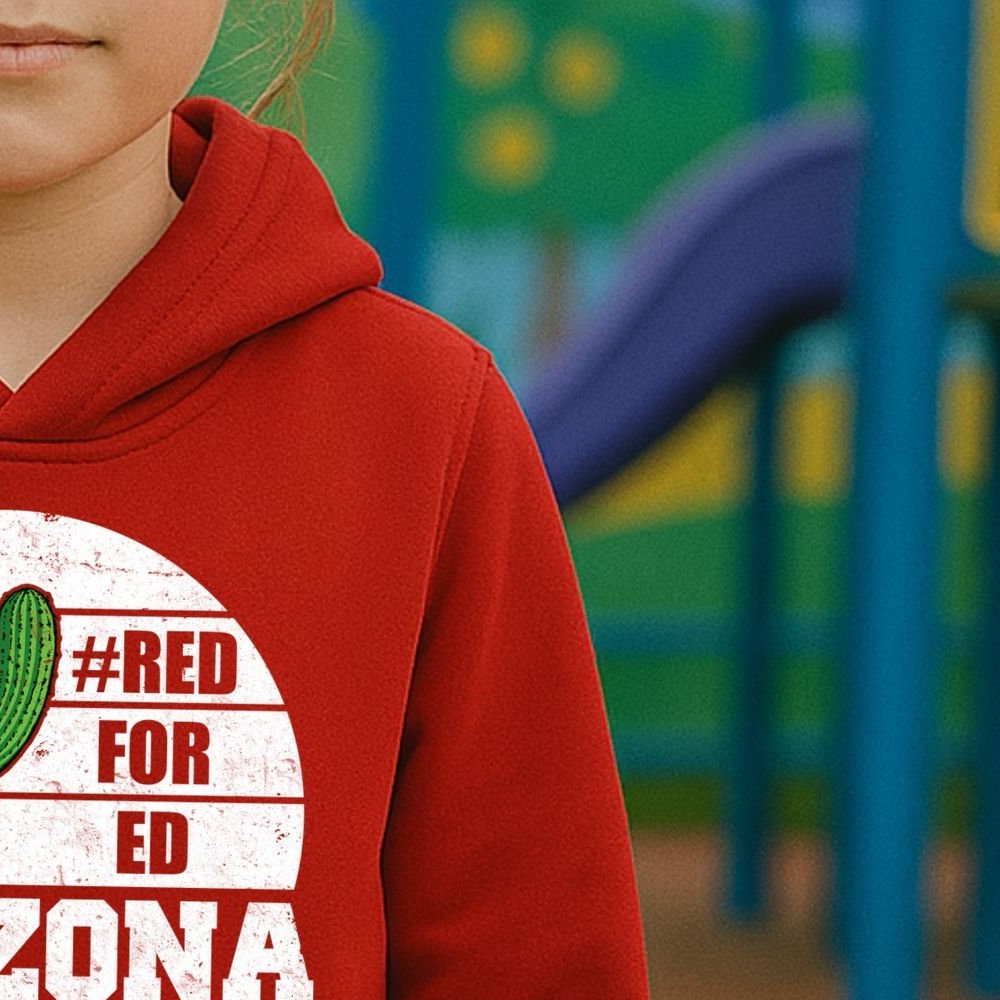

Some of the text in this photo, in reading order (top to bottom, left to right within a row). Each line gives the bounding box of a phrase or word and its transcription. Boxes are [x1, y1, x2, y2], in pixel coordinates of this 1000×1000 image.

[72, 630, 237, 694] #RED
[98, 720, 210, 785] FOR
[116, 811, 188, 874] ED
